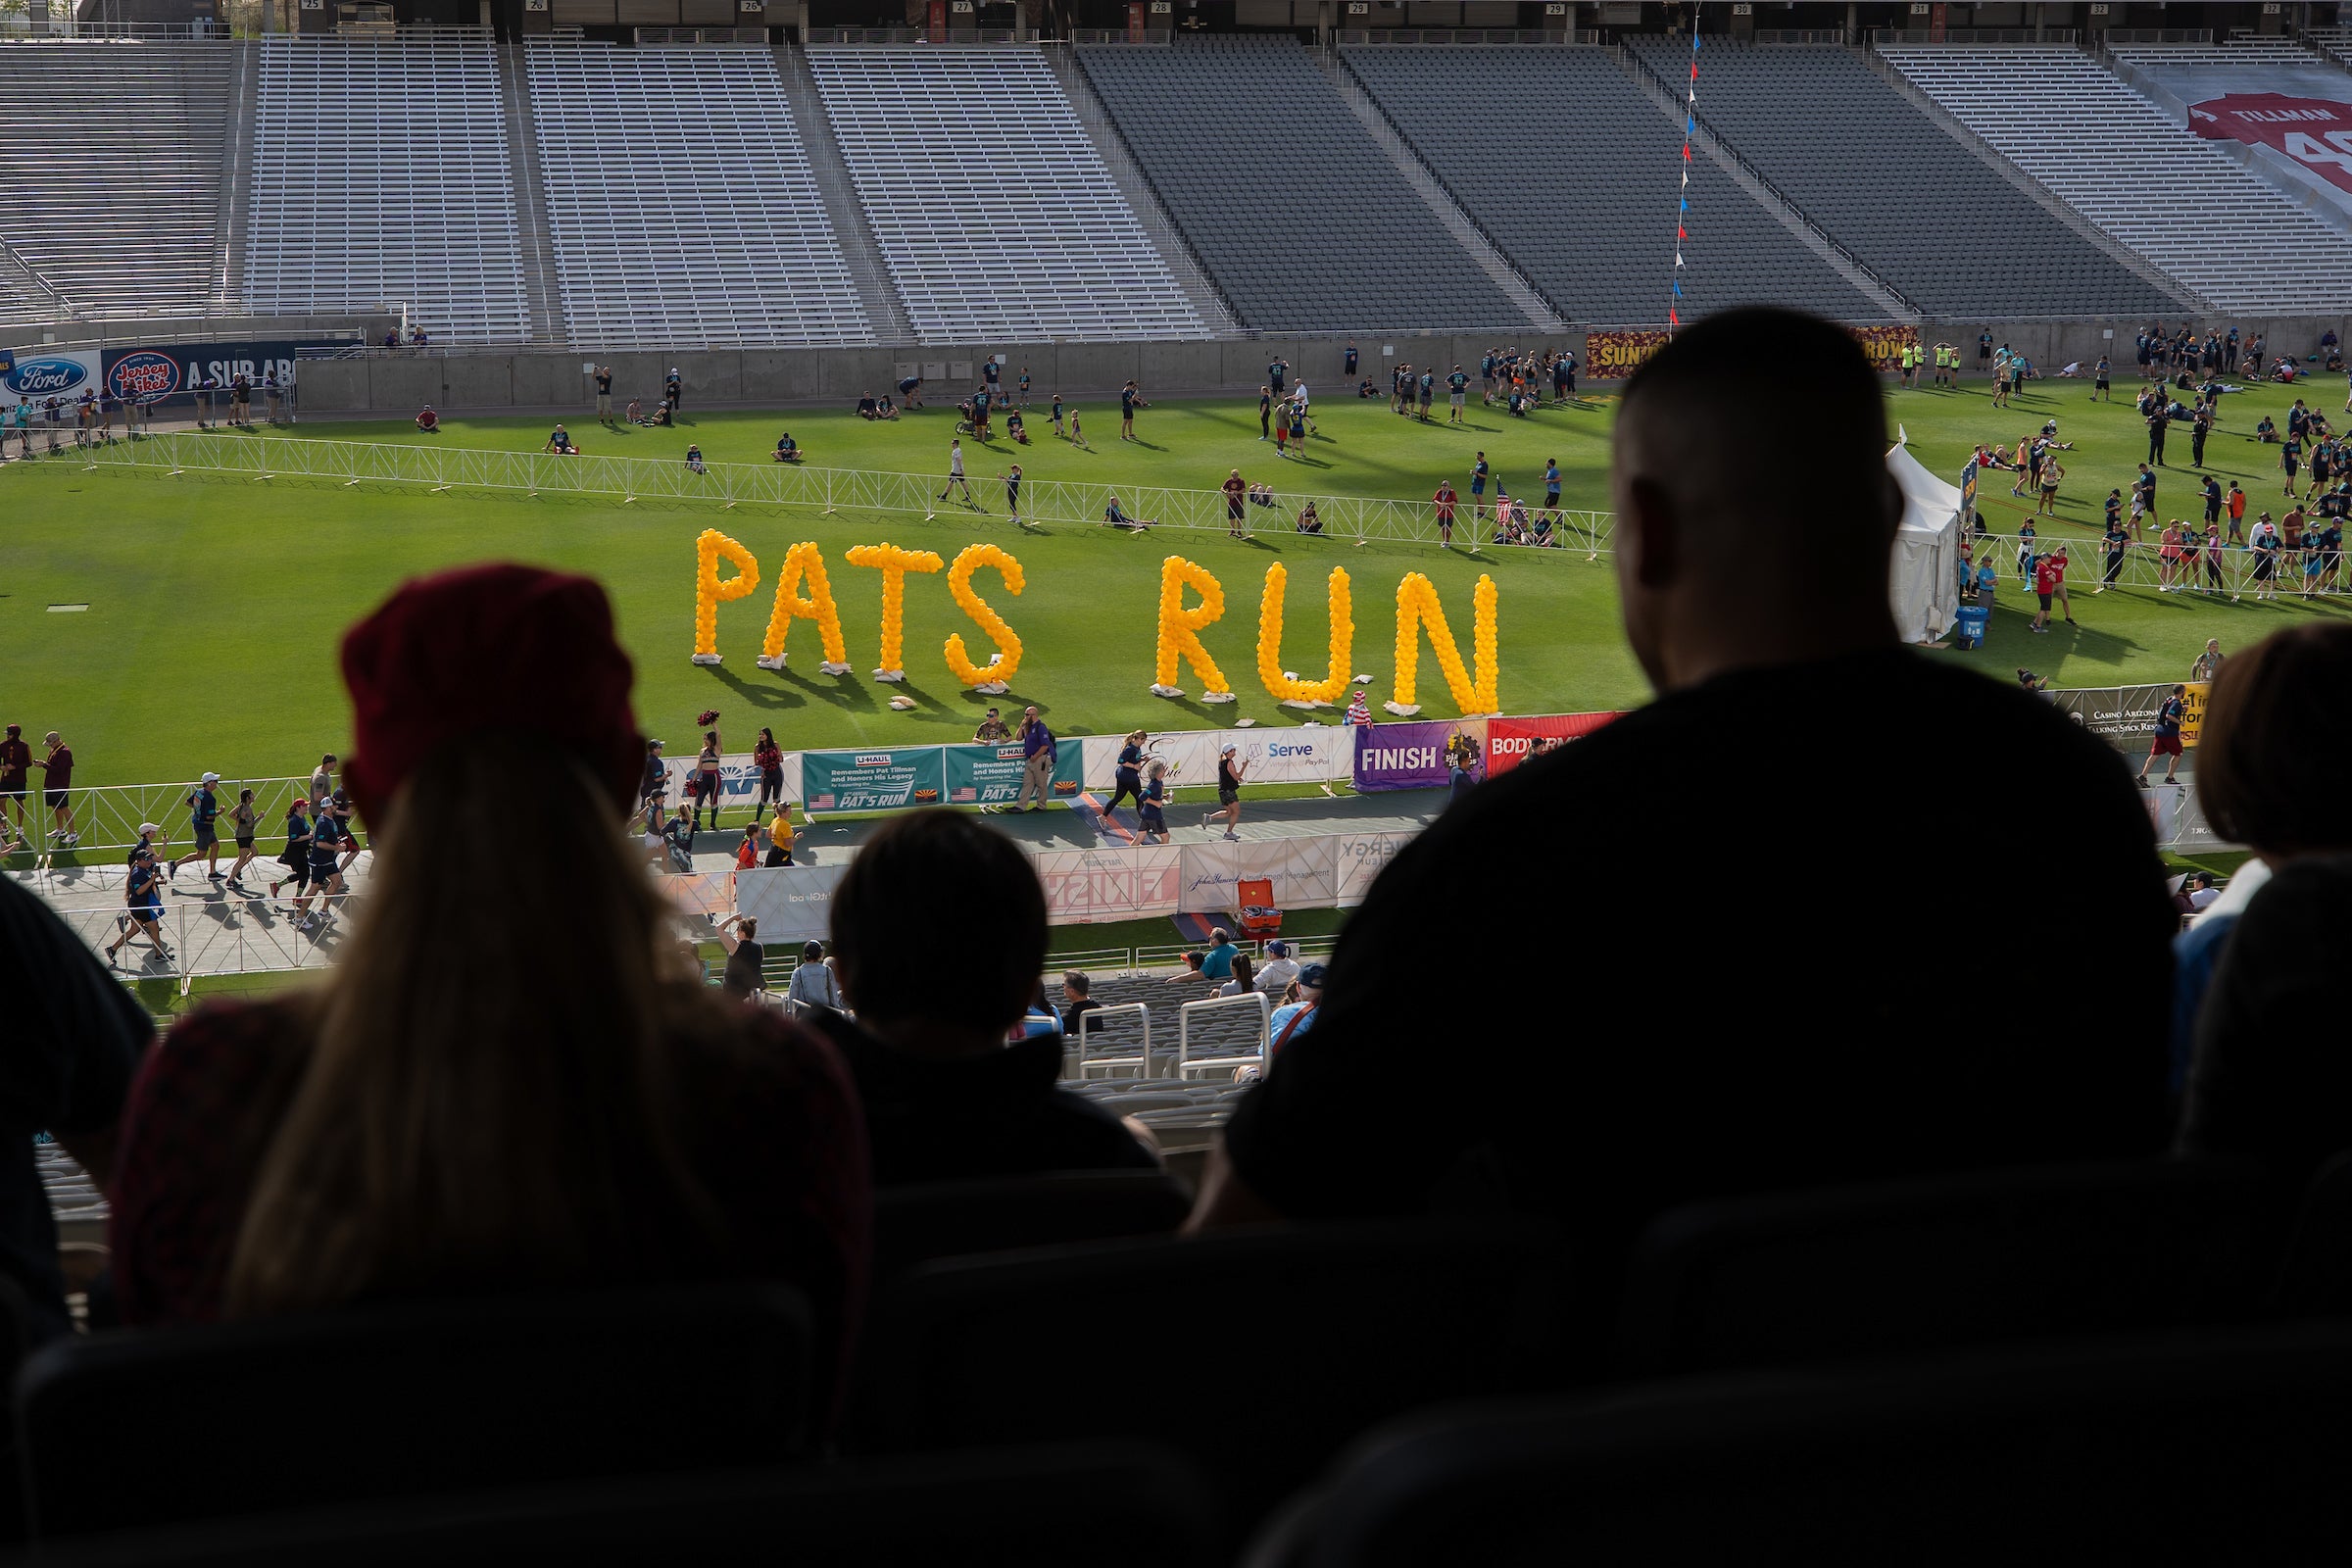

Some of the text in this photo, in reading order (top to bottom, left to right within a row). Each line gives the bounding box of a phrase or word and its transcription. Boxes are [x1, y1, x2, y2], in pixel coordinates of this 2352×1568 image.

[956, 3, 968, 12] 27
[1155, 3, 1167, 12] 28
[1352, 4, 1364, 13] 29
[1550, 5, 1561, 14] 29
[1737, 5, 1747, 14] 30
[2230, 109, 2340, 122] TILLMAN
[1599, 346, 1642, 367] SUN
[1864, 340, 1905, 360] ROW
[19, 364, 70, 391] Ford
[116, 364, 170, 381] Jersey
[186, 359, 296, 390] A SUB AB
[695, 527, 1499, 714] PATS RUN
[1269, 743, 1313, 757] Serve
[1361, 747, 1437, 771] FINISH
[887, 772, 914, 781] Legacy
[839, 794, 878, 808] PAT'S
[981, 787, 1019, 801] PAT'S
[1286, 869, 1330, 880] Management
